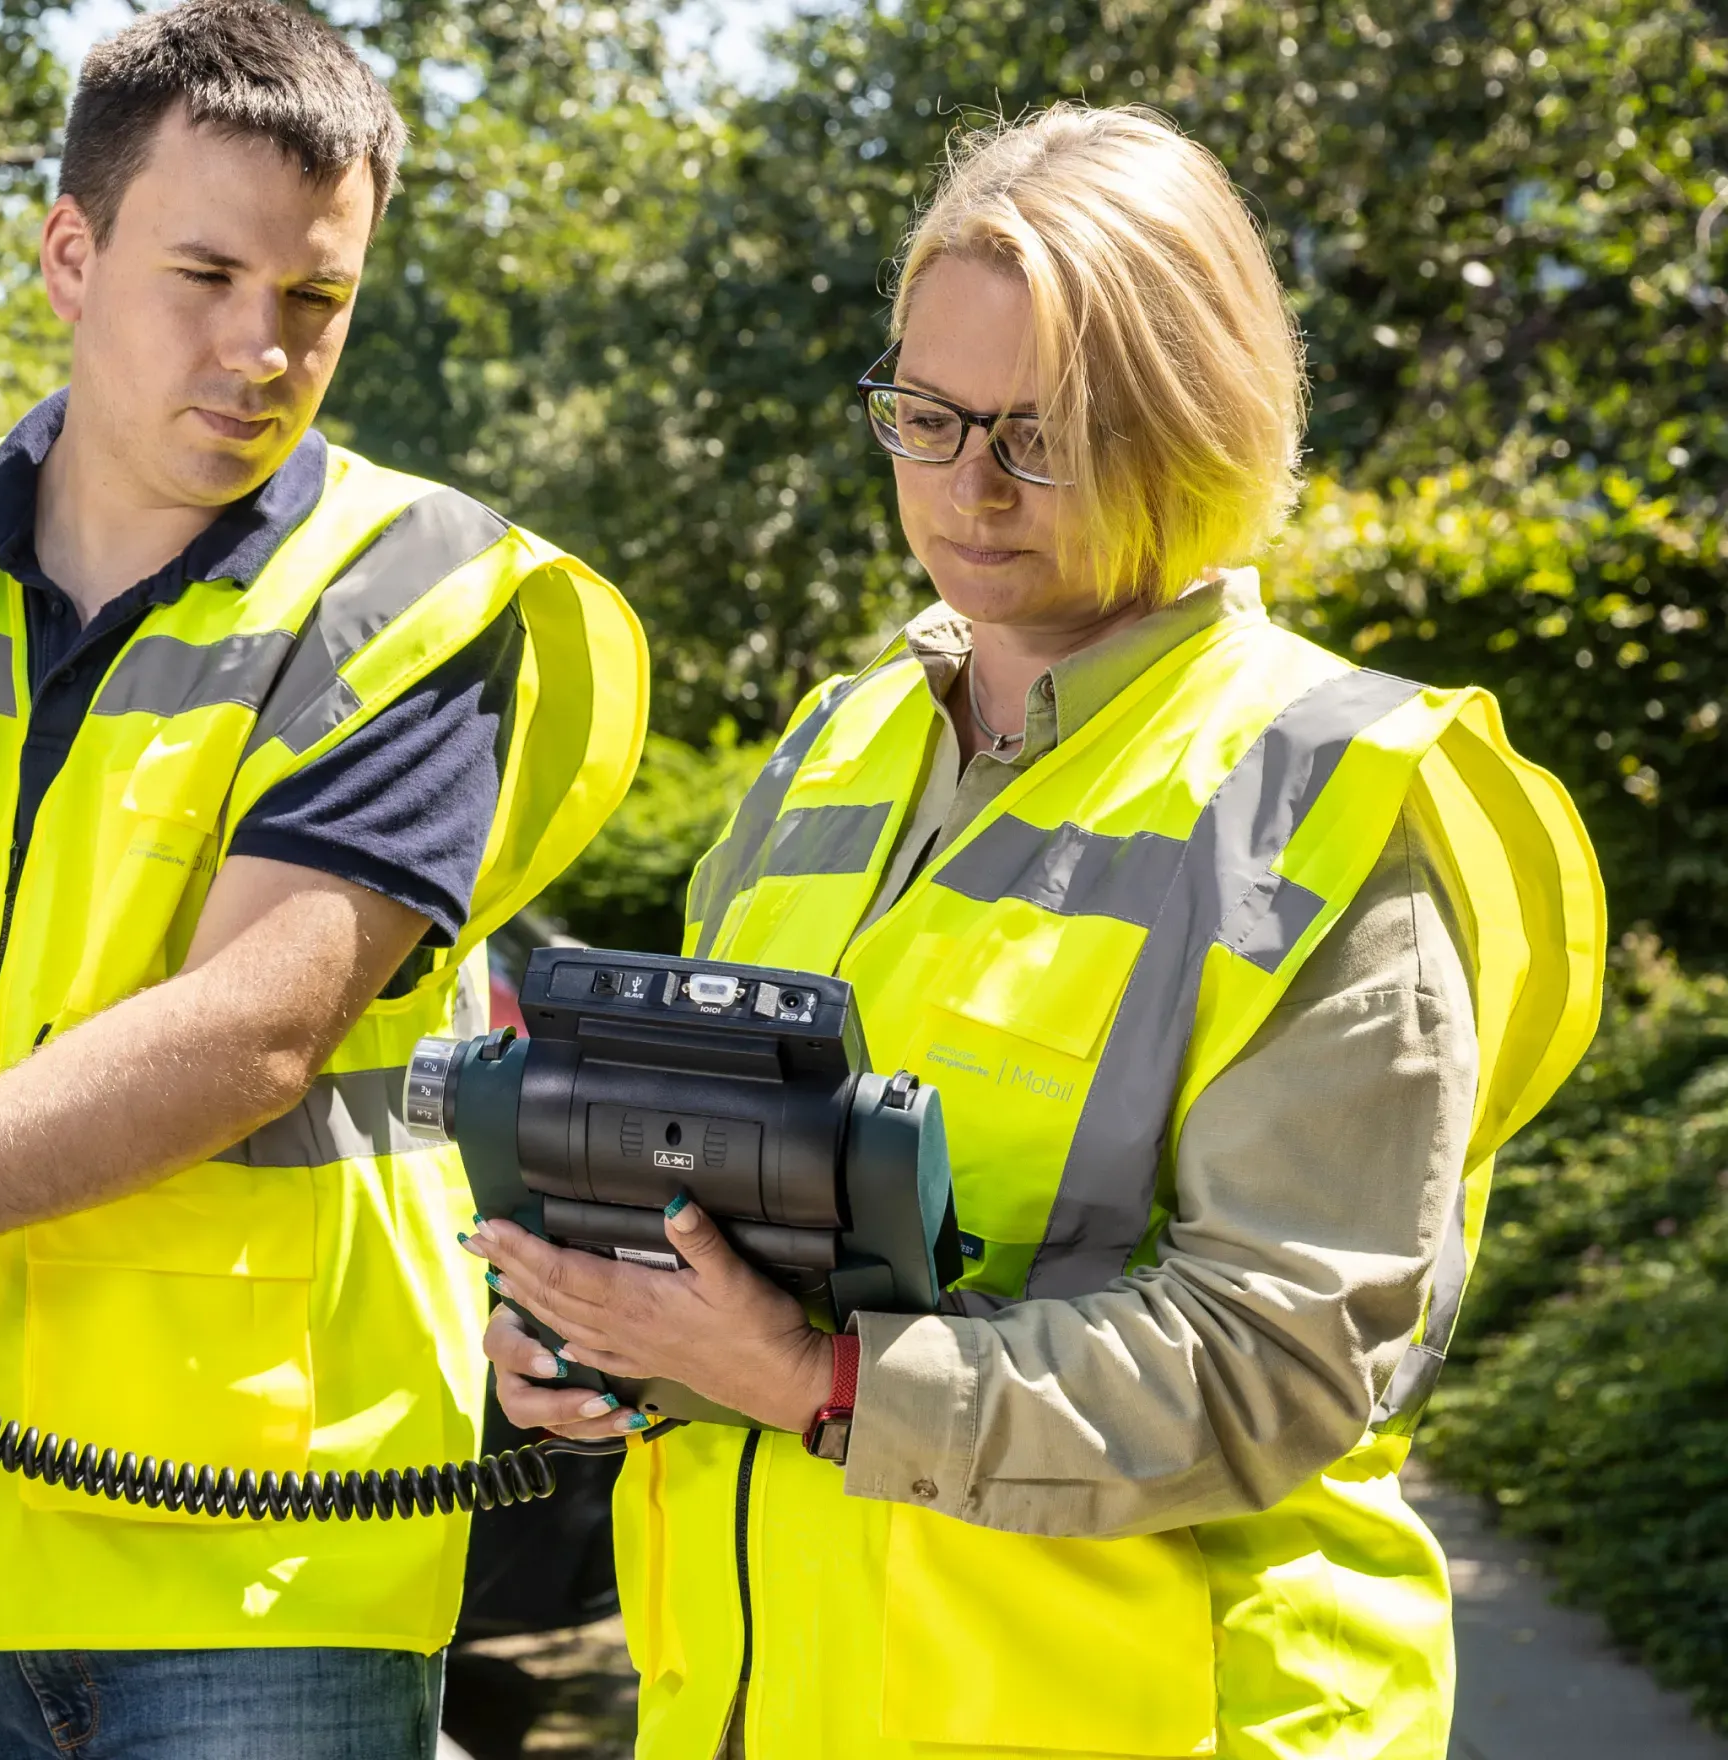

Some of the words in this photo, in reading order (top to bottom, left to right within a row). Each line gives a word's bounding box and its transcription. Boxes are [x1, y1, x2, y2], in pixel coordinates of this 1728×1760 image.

[624, 992, 644, 1000] SLAVE
[926, 1051, 989, 1077] Energiewerke
[1010, 1064, 1075, 1102] Mobil
